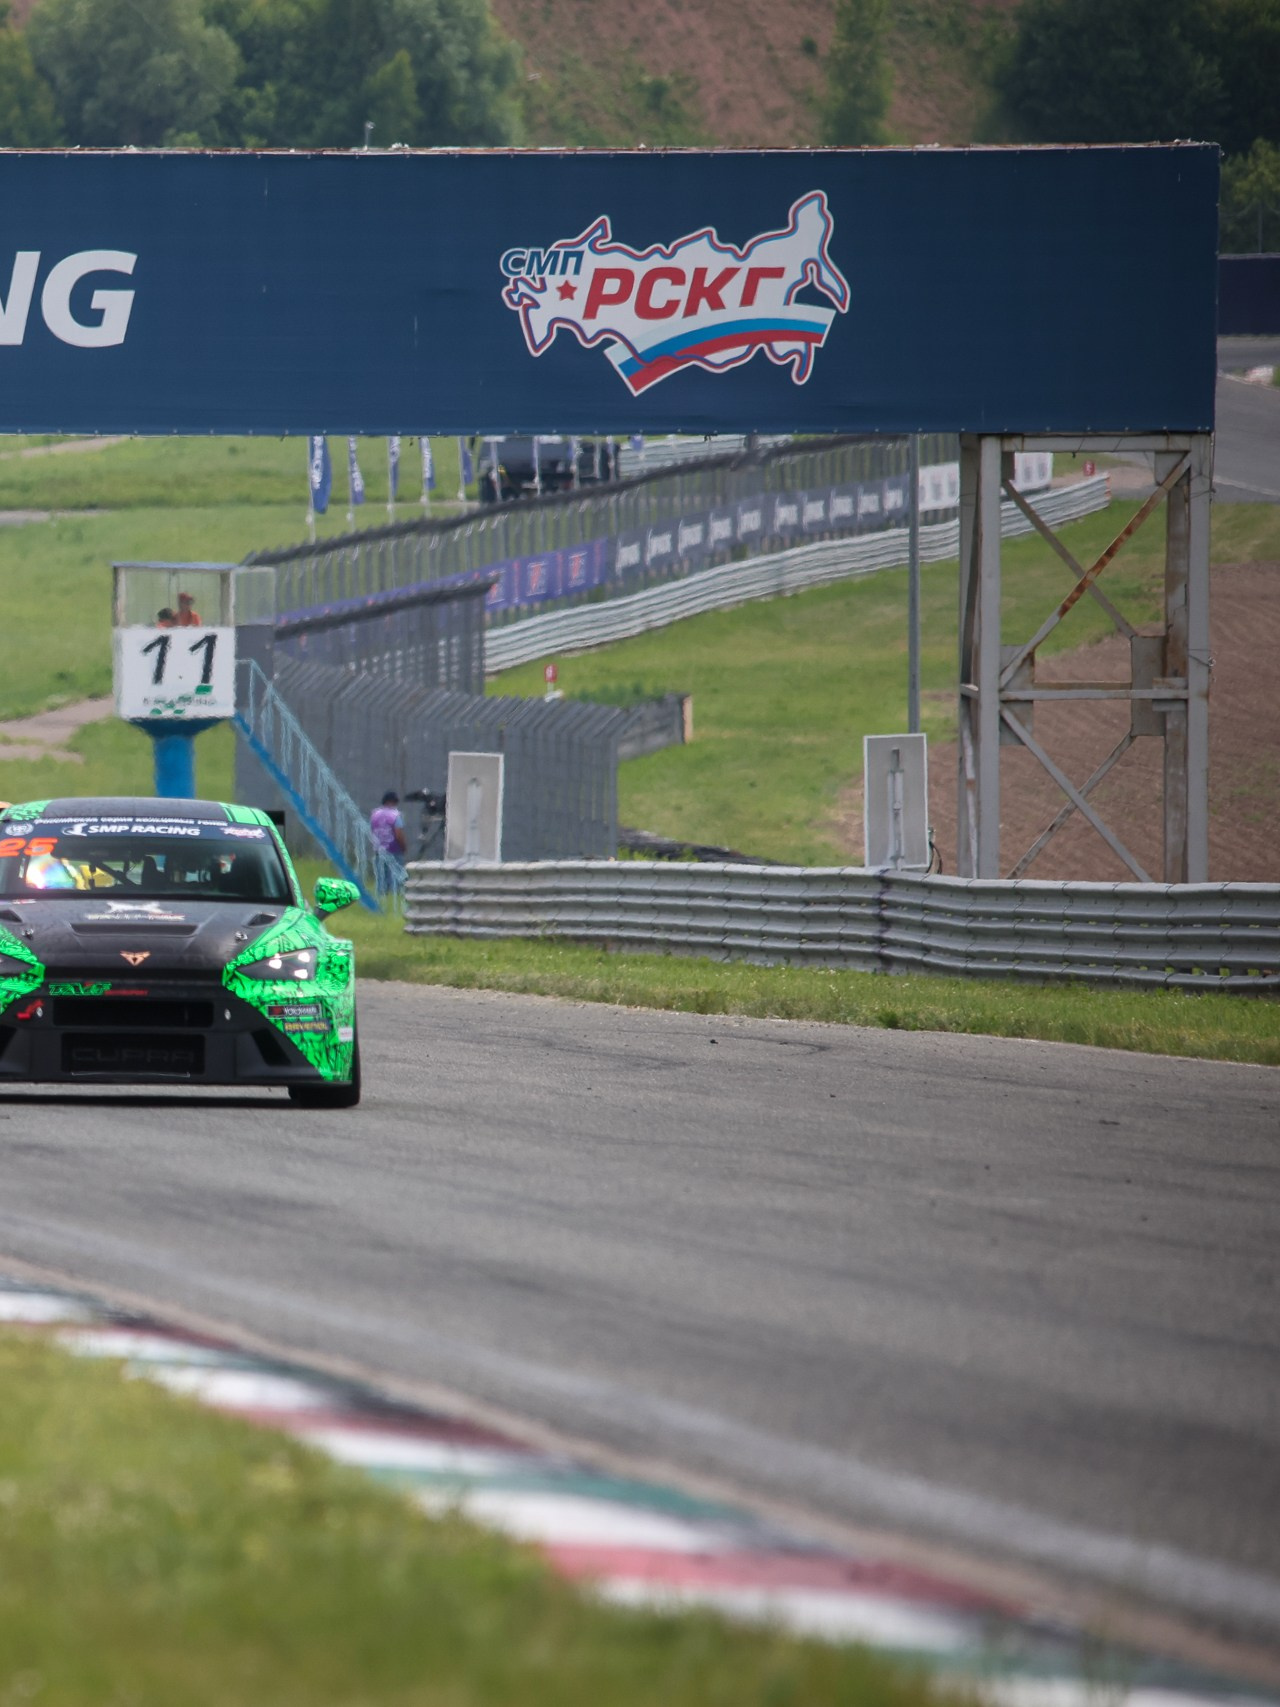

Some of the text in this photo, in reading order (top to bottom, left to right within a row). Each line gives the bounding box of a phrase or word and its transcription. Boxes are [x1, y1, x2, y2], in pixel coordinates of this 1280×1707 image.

[501, 248, 584, 276] СМП
[582, 266, 785, 320] РСКГ
[141, 634, 218, 685] 11
[87, 824, 200, 836] SMP RACING
[70, 1047, 195, 1064] CUPRA
